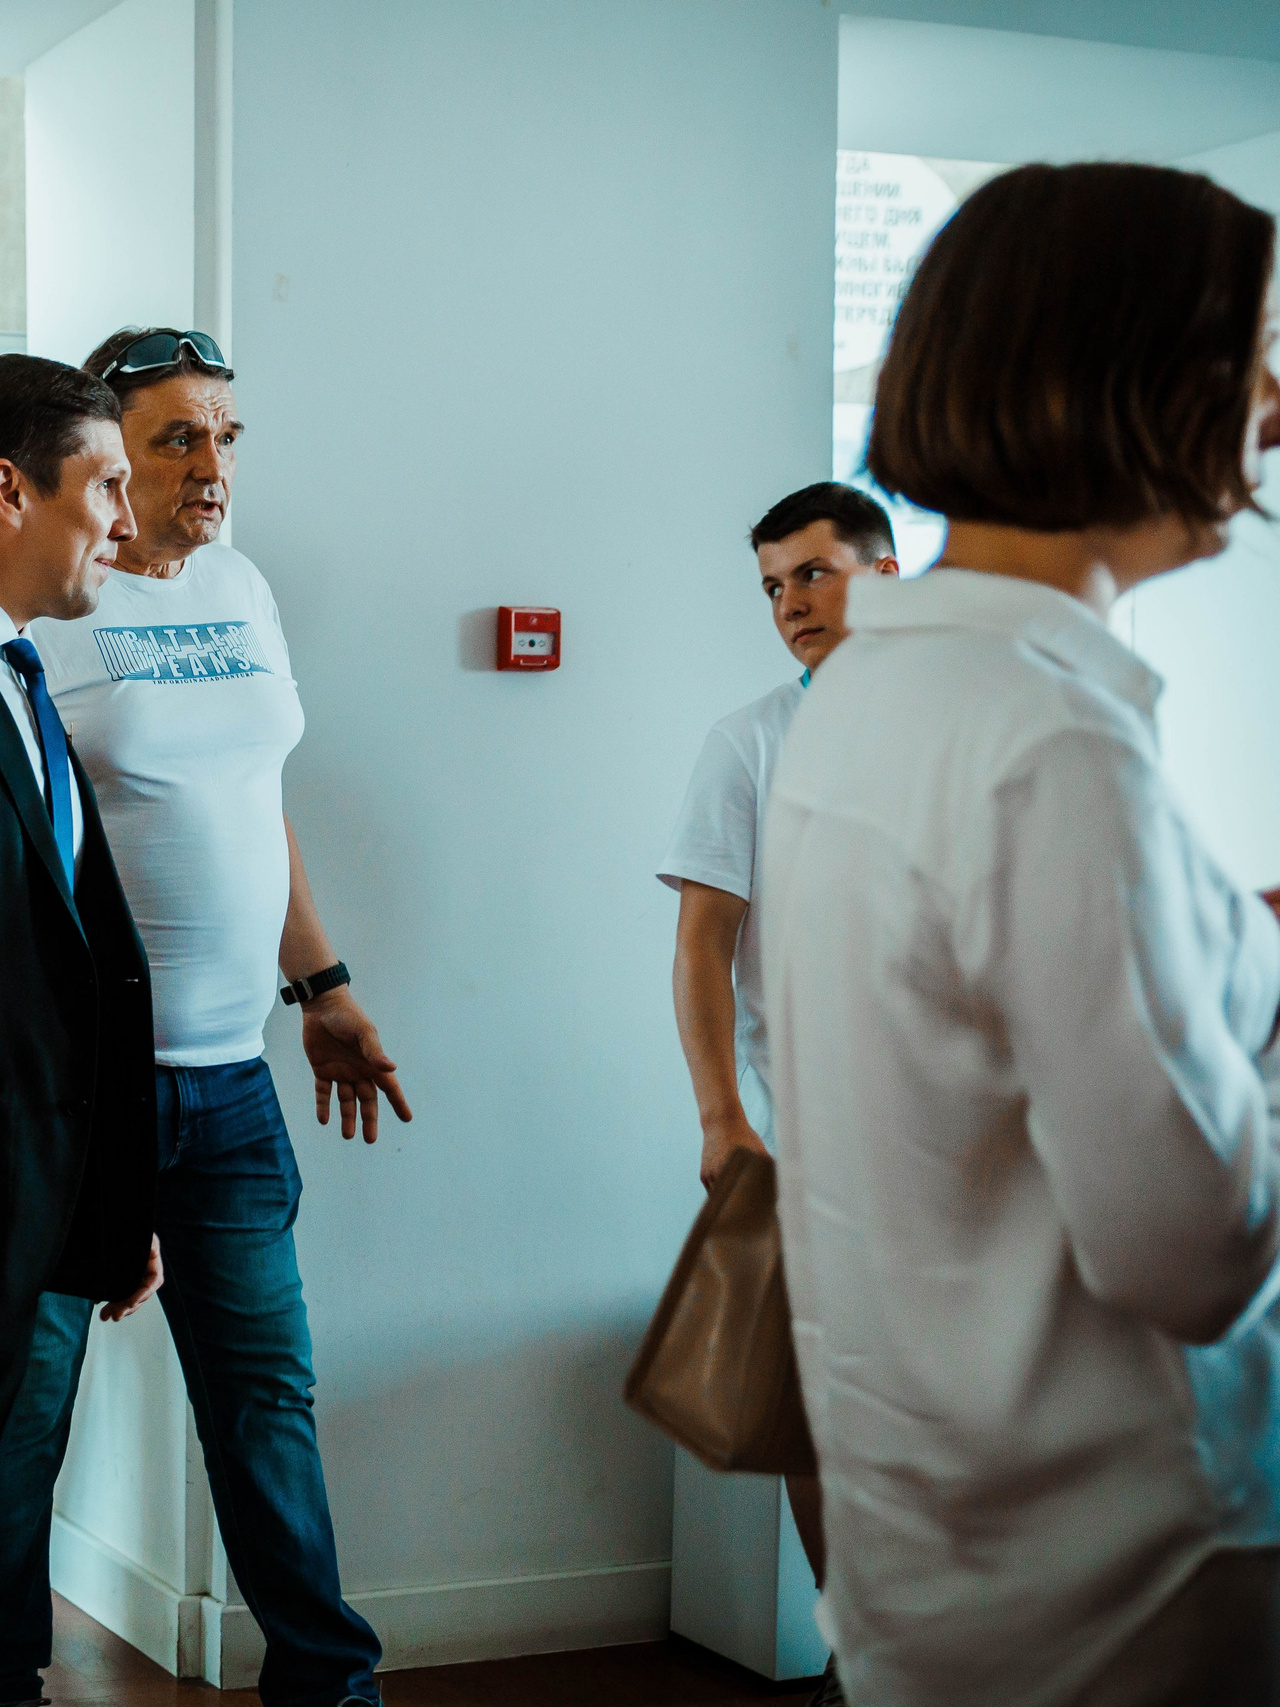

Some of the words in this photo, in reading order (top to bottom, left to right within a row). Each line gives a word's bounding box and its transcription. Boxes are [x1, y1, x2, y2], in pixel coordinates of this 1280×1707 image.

[122, 624, 246, 652] RITTER
[147, 647, 253, 678] JEANS
[169, 677, 209, 685] ORIGINAL
[209, 672, 255, 682] ADVENTURE
